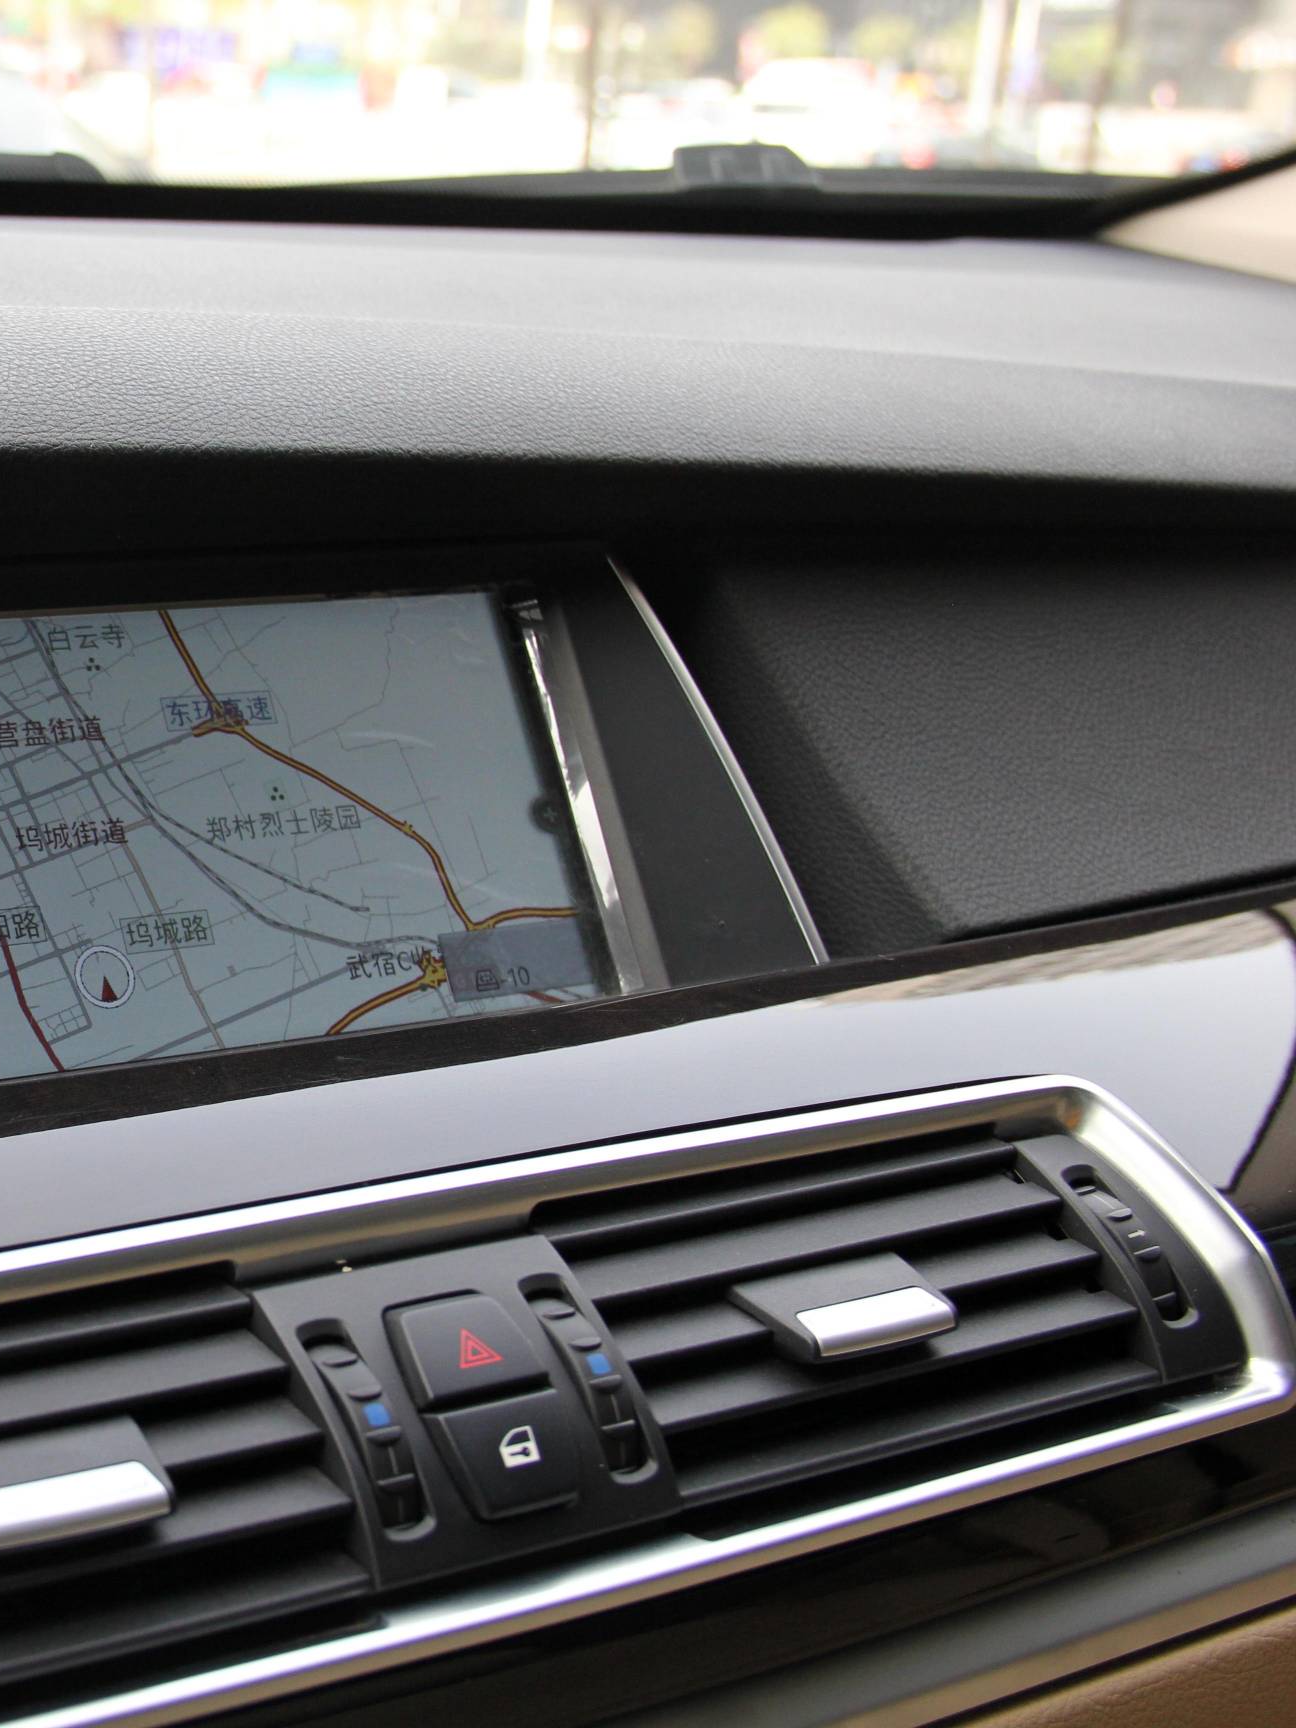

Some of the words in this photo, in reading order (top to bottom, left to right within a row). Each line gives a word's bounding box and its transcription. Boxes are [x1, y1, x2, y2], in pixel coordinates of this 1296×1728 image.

[49, 625, 125, 651] 白云寺
[16, 817, 129, 852] 坞城街道
[206, 805, 361, 842] 郑村烈士陵园
[127, 916, 209, 948] 坞城路
